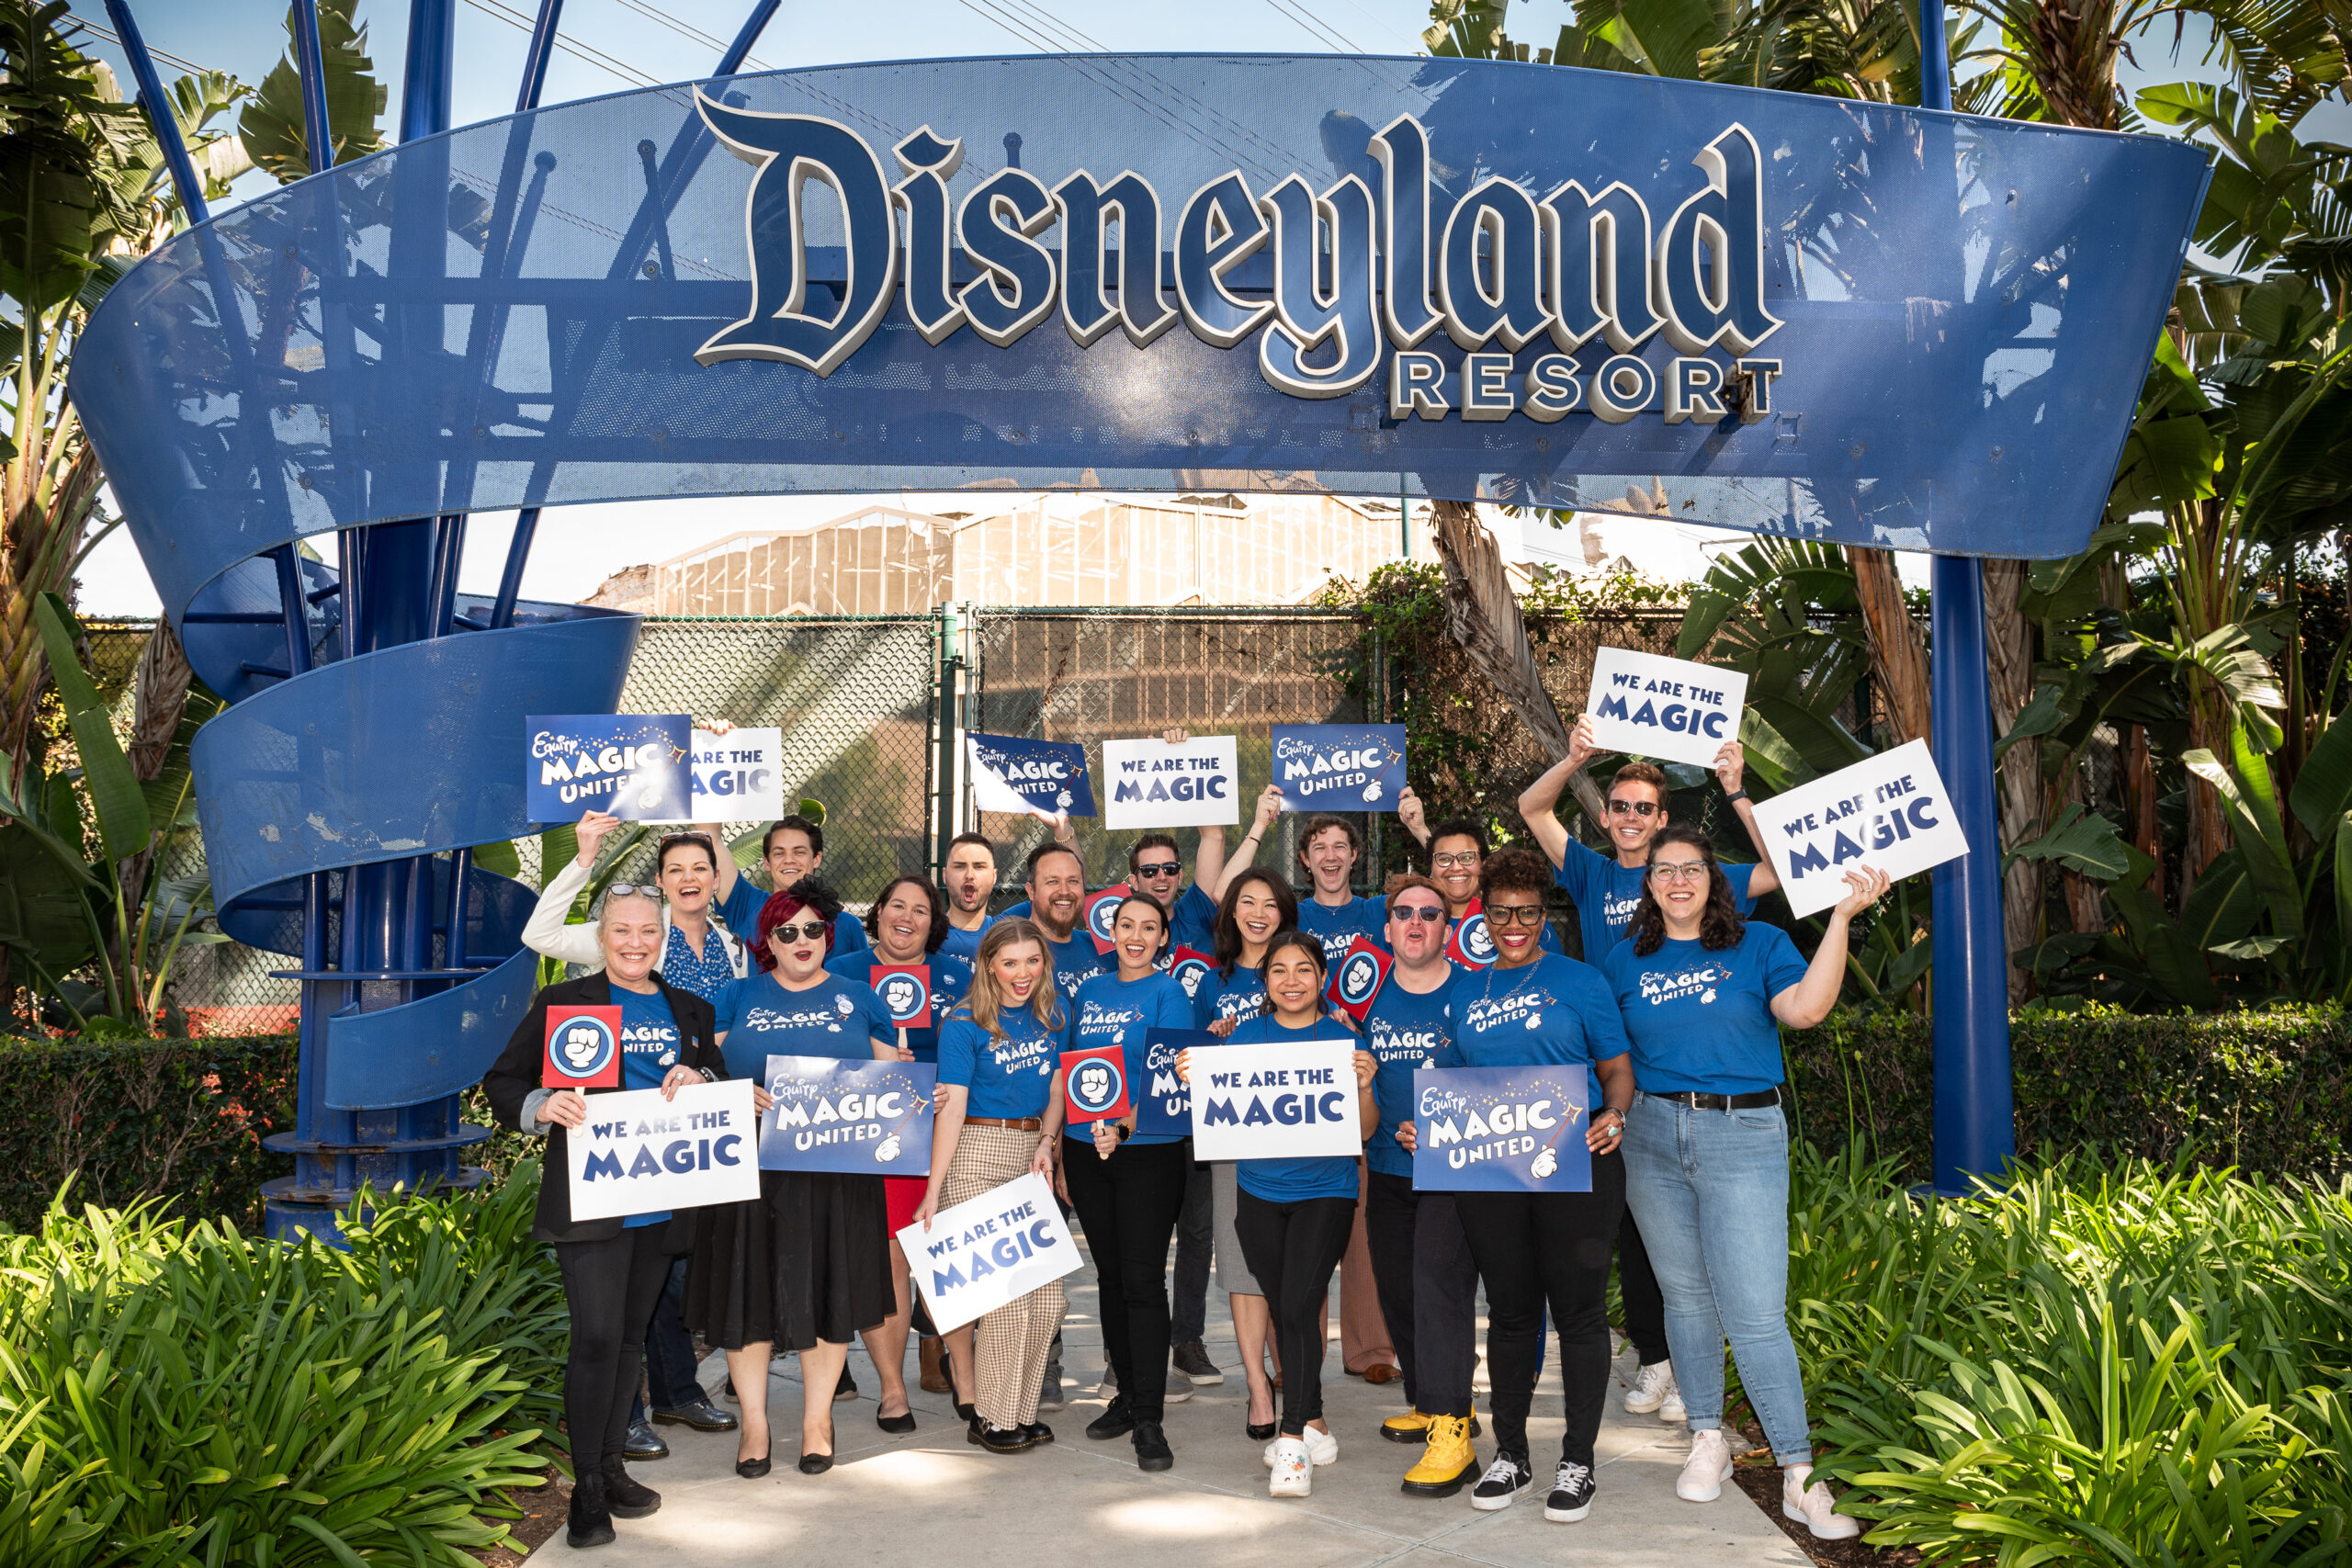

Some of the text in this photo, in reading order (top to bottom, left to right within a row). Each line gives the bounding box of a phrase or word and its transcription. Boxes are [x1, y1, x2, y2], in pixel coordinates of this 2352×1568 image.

[692, 83, 1785, 401] Disneyland
[1391, 351, 1781, 423] RESORT
[1612, 673, 1724, 705] WE ARE THE
[1596, 693, 1729, 739] MAGIC
[532, 731, 578, 759] Equity
[730, 750, 763, 762] THE
[1276, 738, 1314, 760] Equity
[540, 742, 662, 785] MAGIC
[1121, 758, 1219, 773] WE ARE THE
[1284, 748, 1382, 780] MAGIC
[691, 769, 771, 795] AGIC
[1012, 782, 1057, 794] NITED
[1114, 775, 1227, 803] MAGIC
[1299, 773, 1366, 795] UNITED
[1783, 774, 1917, 839] WE ARE THE
[1789, 796, 1939, 878] MAGIC
[1639, 972, 1666, 987] Equity
[1642, 969, 1717, 998] MAGIC
[1217, 994, 1239, 1008] Equity
[1651, 984, 1703, 1005] UNITED
[746, 1007, 777, 1020] Equity
[746, 1011, 834, 1027] MAGIC
[1079, 1010, 1133, 1026] MAGIC
[1466, 993, 1542, 1025] MAGIC
[1476, 1008, 1528, 1032] UNITED
[620, 1027, 677, 1042] AGIC
[757, 1021, 825, 1032] UNITED
[1080, 1024, 1119, 1036] UNITED
[1371, 1017, 1392, 1033] Equity
[623, 1043, 664, 1054] NITED
[995, 1039, 1048, 1065] MAGIC
[1371, 1032, 1436, 1050] MAGIC
[1006, 1056, 1040, 1075] UNITED
[1380, 1049, 1424, 1063] UNITED
[770, 1073, 819, 1100] Equity
[1210, 1072, 1241, 1089] WE
[1248, 1070, 1289, 1088] ARE
[1295, 1068, 1334, 1085] THE
[775, 1091, 904, 1131] MAGIC
[1204, 1091, 1345, 1127] MAGIC
[1419, 1087, 1466, 1117] Equity
[592, 1110, 730, 1140] WE ARE THE
[795, 1122, 882, 1151] UNITED
[1429, 1100, 1558, 1148] MAGIC
[582, 1134, 742, 1182] MAGIC
[1448, 1135, 1535, 1169] UNITED
[927, 1201, 1036, 1259] WE ARE THE
[933, 1219, 1057, 1297] MAGIC
